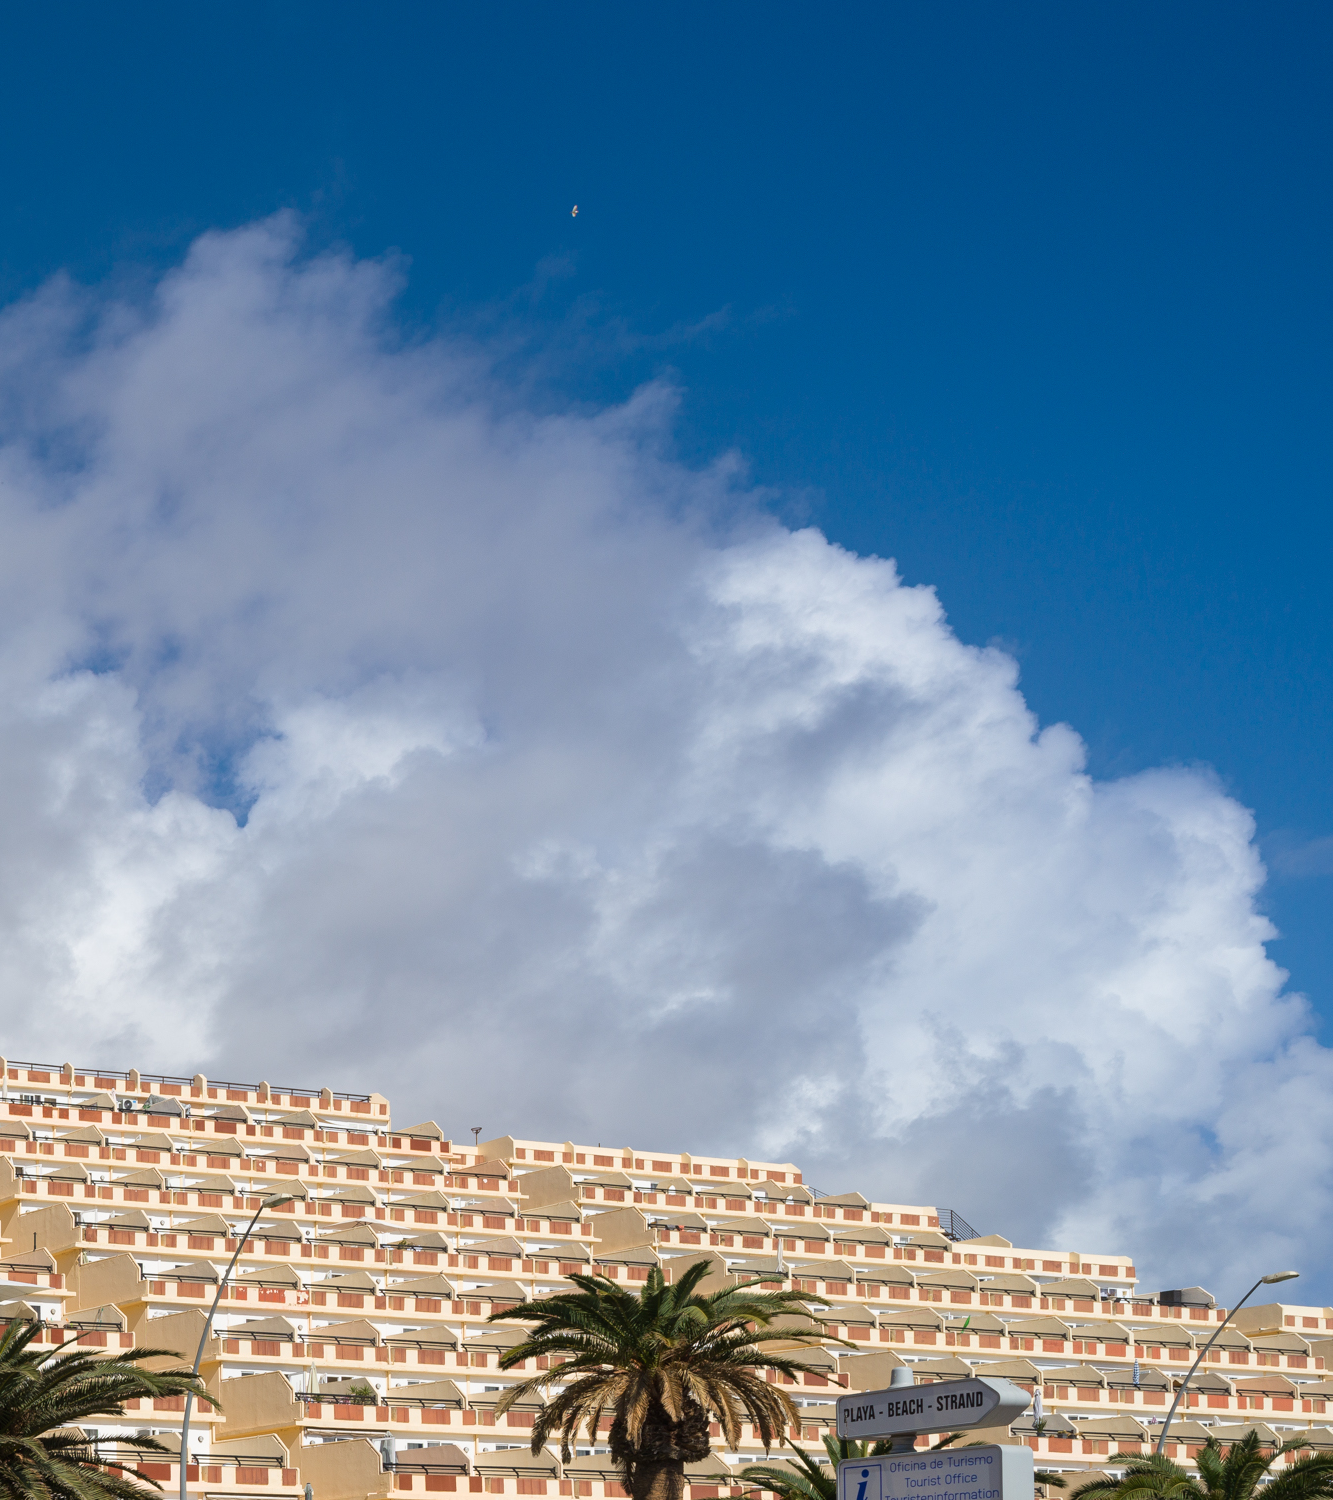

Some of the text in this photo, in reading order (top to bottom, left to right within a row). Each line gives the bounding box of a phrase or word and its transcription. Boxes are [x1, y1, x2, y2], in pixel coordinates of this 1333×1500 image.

[843, 1405, 875, 1423] PLAYA
[887, 1398, 924, 1417] BEACH
[936, 1391, 983, 1412] STRAND
[889, 1455, 993, 1473] Oficina de Turismo
[905, 1473, 977, 1488] Tourist Office
